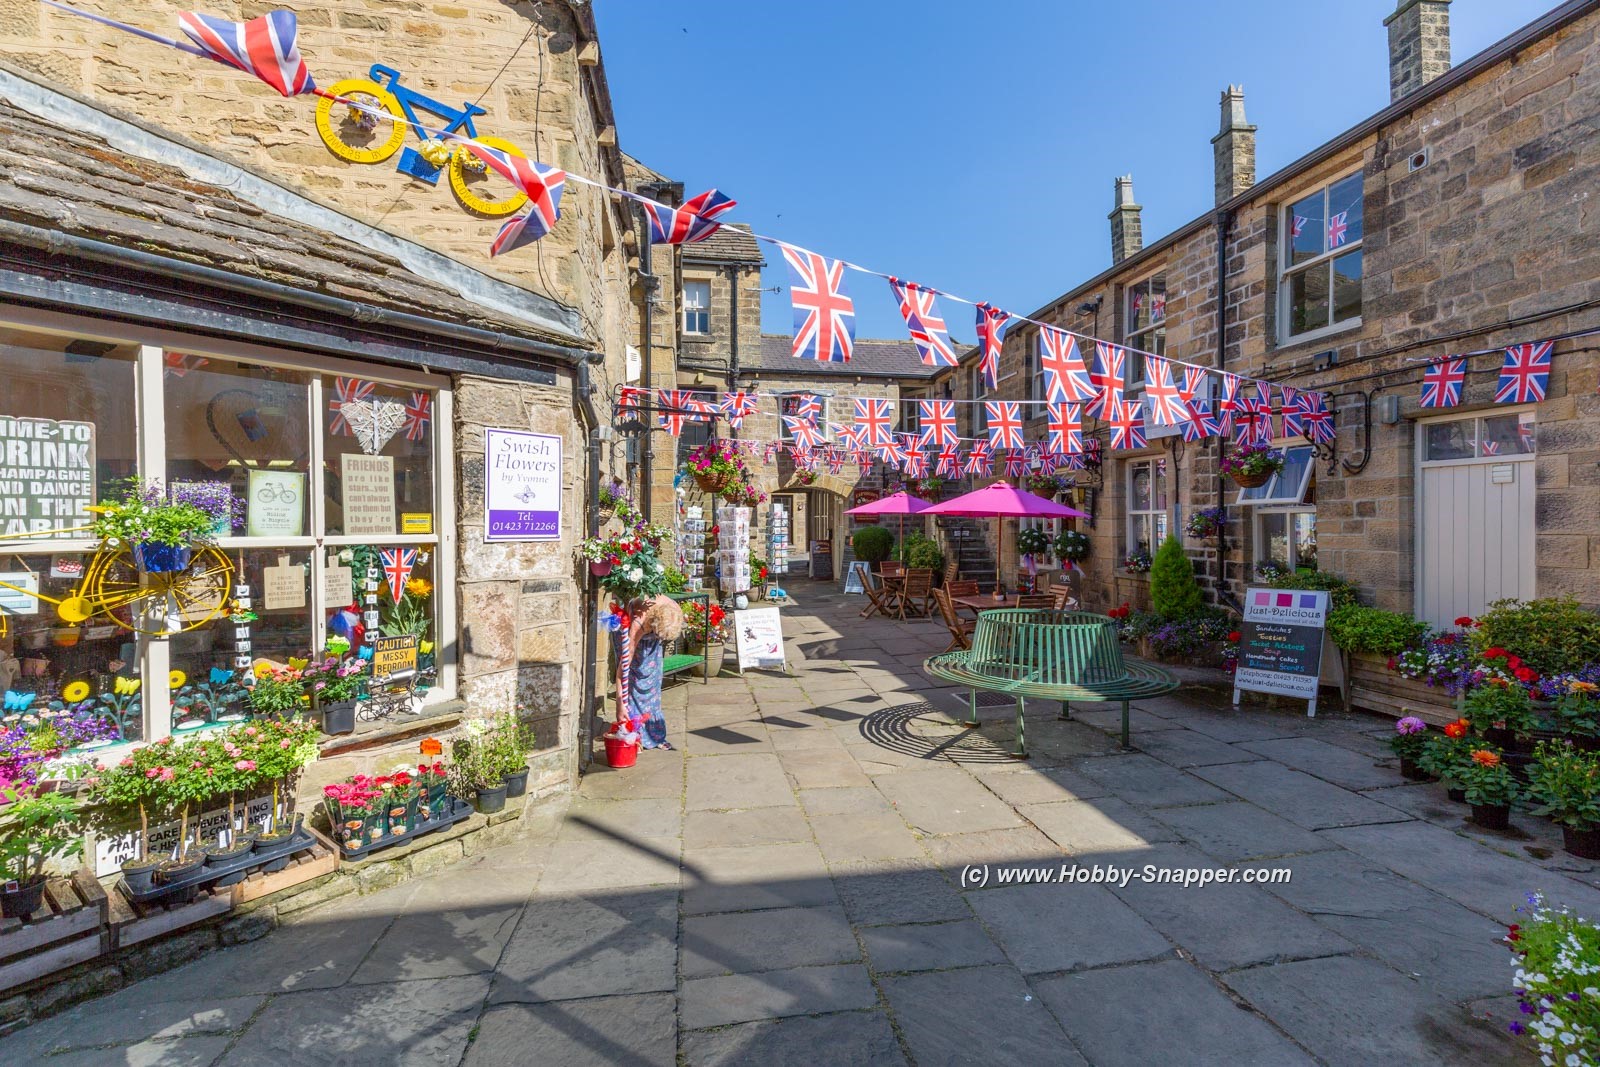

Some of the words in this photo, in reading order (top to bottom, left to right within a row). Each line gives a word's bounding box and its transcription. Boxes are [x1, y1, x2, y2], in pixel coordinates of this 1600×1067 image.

[0, 439, 91, 468] RINK
[500, 437, 550, 456] Swish
[347, 459, 389, 472] FRIENDS
[495, 453, 556, 472] Flowers
[0, 467, 91, 481] HAMPAGNE
[501, 472, 513, 484] by
[517, 473, 549, 484] Yvonne
[0, 481, 24, 494] ND
[30, 481, 91, 495] DANCE
[37, 498, 91, 516] THE
[518, 512, 534, 520] Tel:
[0, 518, 91, 539] ABLE
[492, 521, 521, 531] 01423
[524, 522, 556, 531] 712266
[1248, 606, 1321, 619] Just-Delicious
[378, 636, 414, 651] CAUTION
[382, 650, 409, 663] MESSY
